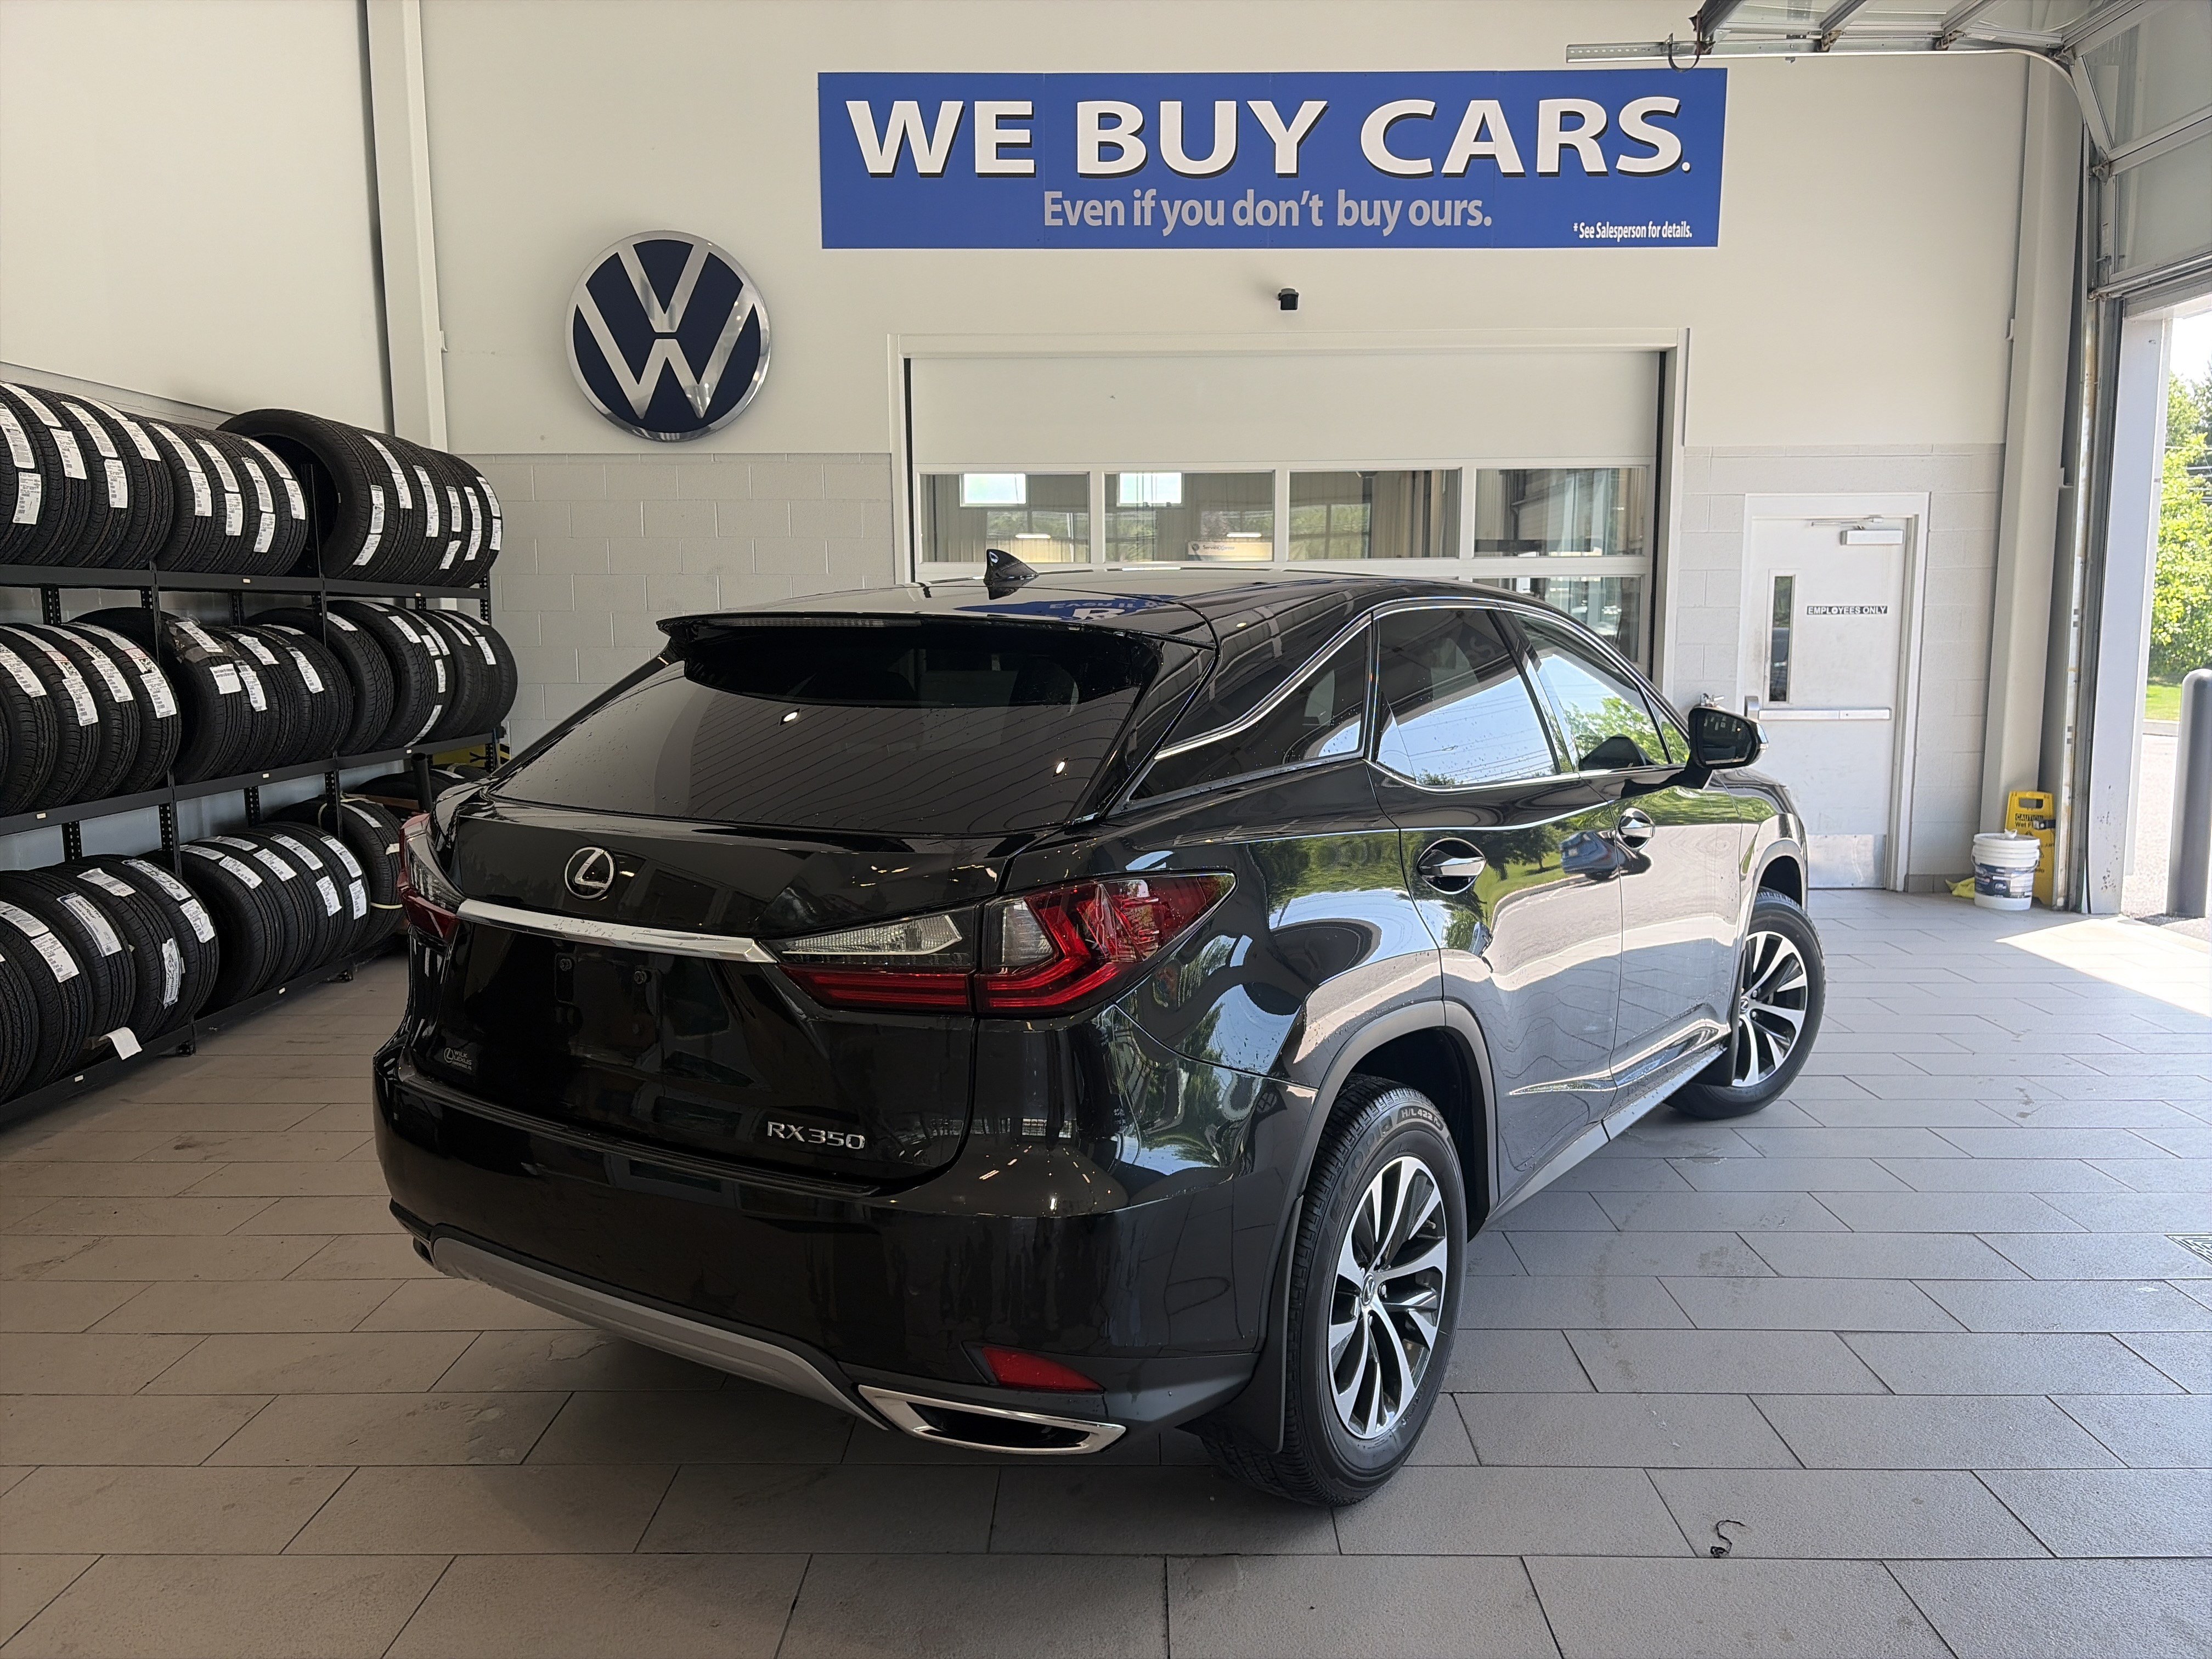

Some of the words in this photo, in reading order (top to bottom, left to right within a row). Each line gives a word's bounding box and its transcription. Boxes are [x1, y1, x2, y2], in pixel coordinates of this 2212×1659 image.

[846, 100, 1035, 176] WE
[1076, 100, 1328, 177] BUY
[1361, 97, 1691, 176] CARS.
[1044, 190, 1125, 227] Even
[1133, 189, 1156, 226] if
[1160, 199, 1224, 236] you
[1233, 189, 1324, 227] don't
[1337, 189, 1403, 237] buy
[1408, 200, 1492, 227] ours.
[1596, 221, 1646, 242] Salesperson
[1648, 221, 1661, 238] for
[1662, 221, 1692, 238] details.
[1808, 606, 1860, 614] EMPLOYEES
[1863, 606, 1886, 614] ONLY
[808, 1128, 865, 1150] 350
